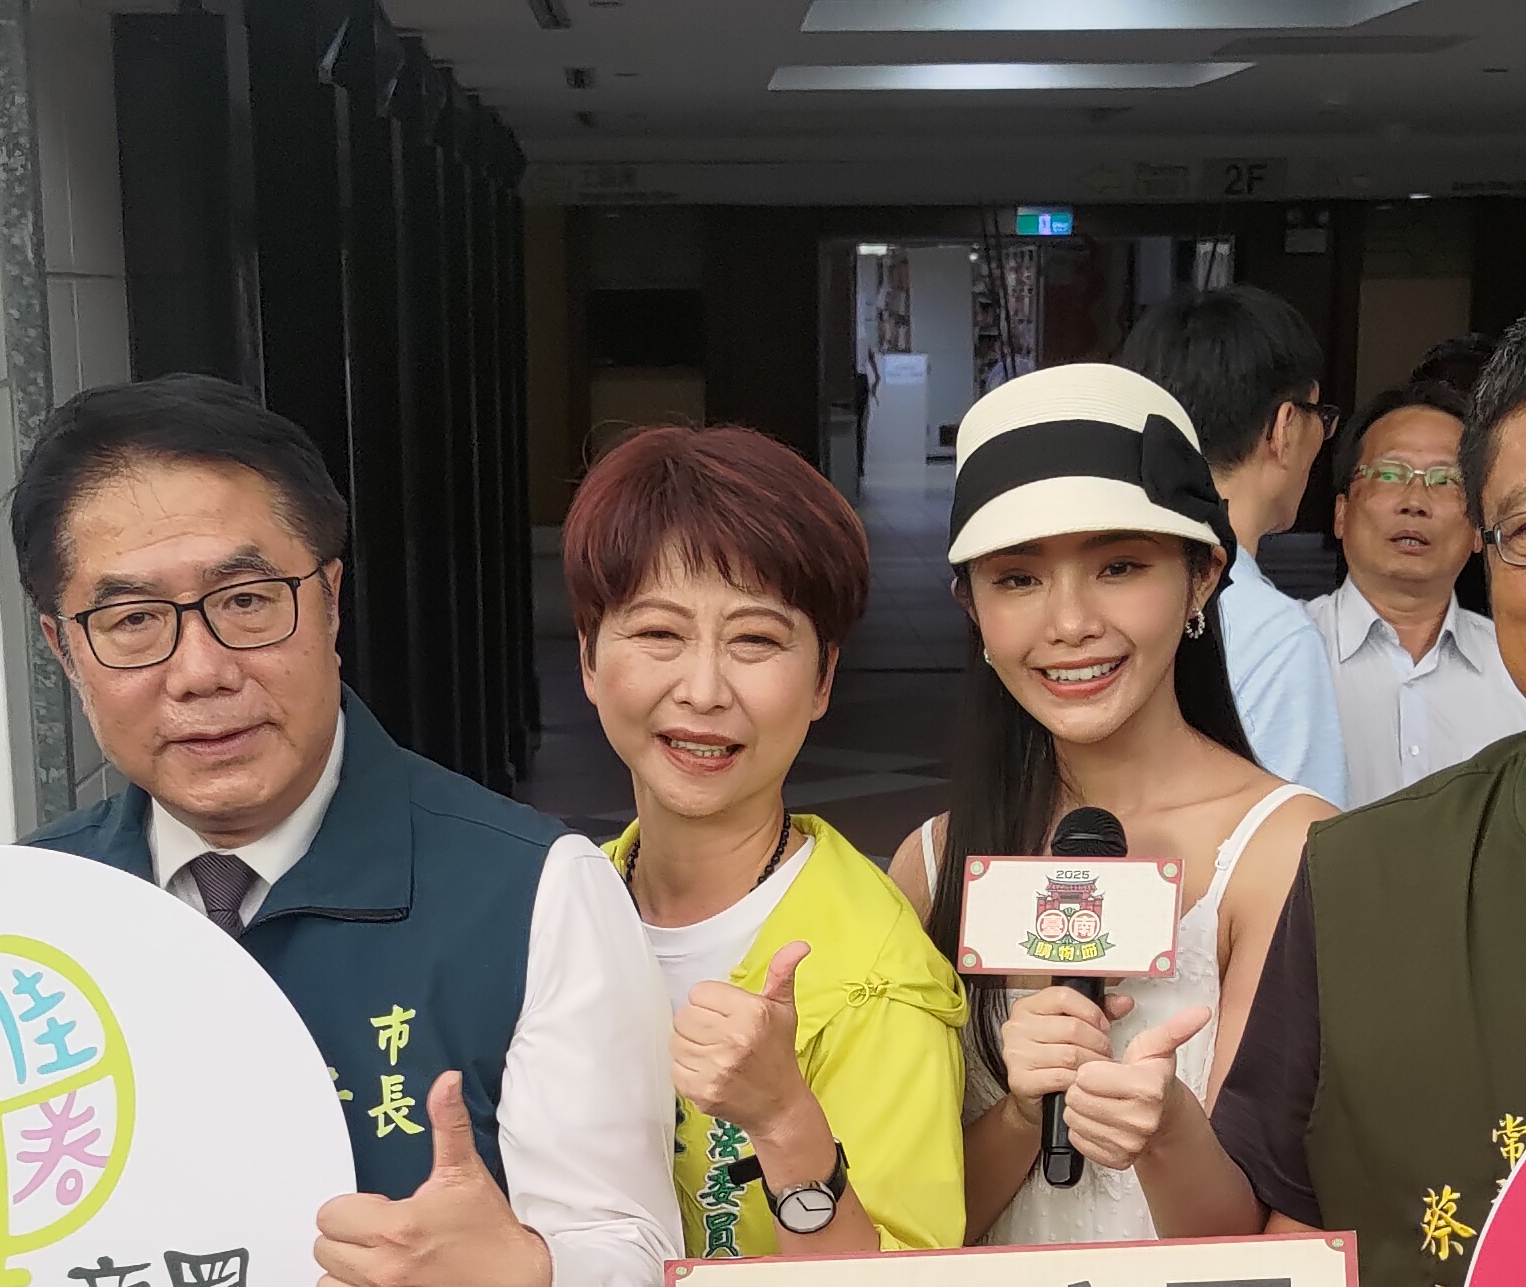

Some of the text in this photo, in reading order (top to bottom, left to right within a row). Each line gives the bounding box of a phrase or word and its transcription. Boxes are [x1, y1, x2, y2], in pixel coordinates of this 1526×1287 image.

[1224, 162, 1267, 196] 2F
[1056, 870, 1091, 880] 2025
[368, 1004, 425, 1137] 市長
